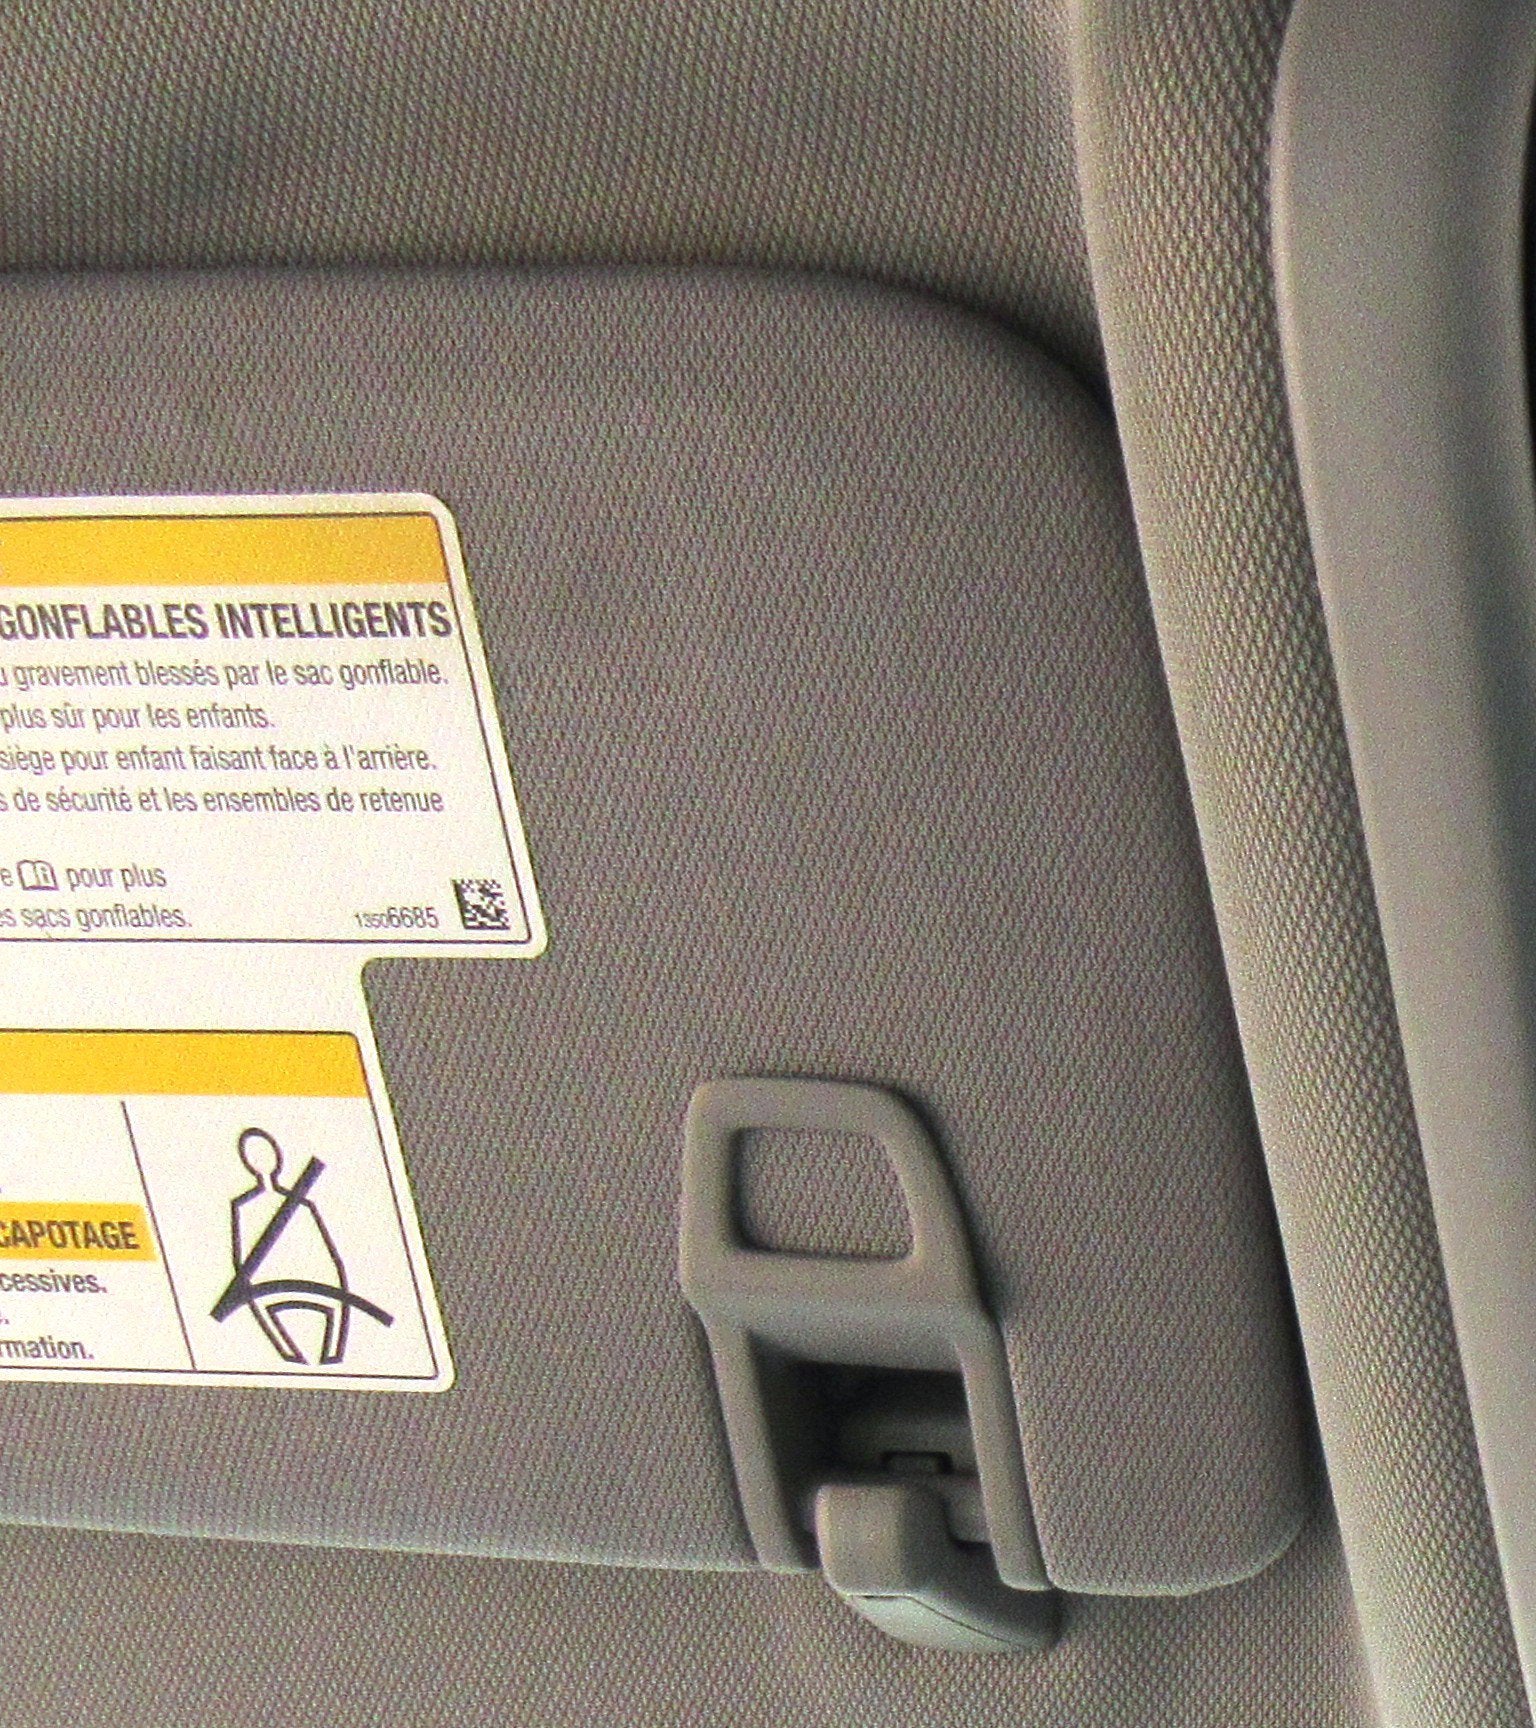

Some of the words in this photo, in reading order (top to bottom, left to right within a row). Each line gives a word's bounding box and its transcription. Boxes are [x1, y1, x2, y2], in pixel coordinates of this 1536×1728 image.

[0, 603, 209, 640] GONFLABLES
[215, 602, 452, 639] INTELLIGENTS
[14, 660, 131, 691] gravement
[135, 659, 219, 686] blessés
[224, 664, 259, 691] par
[266, 660, 288, 686] le
[293, 664, 333, 686] sac
[340, 658, 449, 690] gonflable.
[0, 702, 47, 734] plus
[51, 702, 85, 729] sûr
[92, 707, 140, 733] pour
[146, 703, 181, 728] les
[187, 703, 275, 729] enfants.
[0, 744, 55, 775] siège
[61, 749, 109, 775] pour
[115, 745, 186, 770] enfant
[190, 745, 266, 770] faisant
[269, 745, 318, 770] face
[324, 743, 340, 770] à
[343, 743, 437, 770] l'arrière.
[13, 787, 41, 811] de
[46, 785, 132, 812] sécurité
[139, 787, 162, 811] et
[163, 787, 198, 812] les
[202, 787, 321, 812] ensembles
[326, 787, 354, 812] de
[360, 788, 444, 812] retenue
[66, 867, 114, 892] pour
[120, 863, 167, 892] plus
[21, 908, 71, 928] sacs
[76, 903, 192, 932] gonflables.
